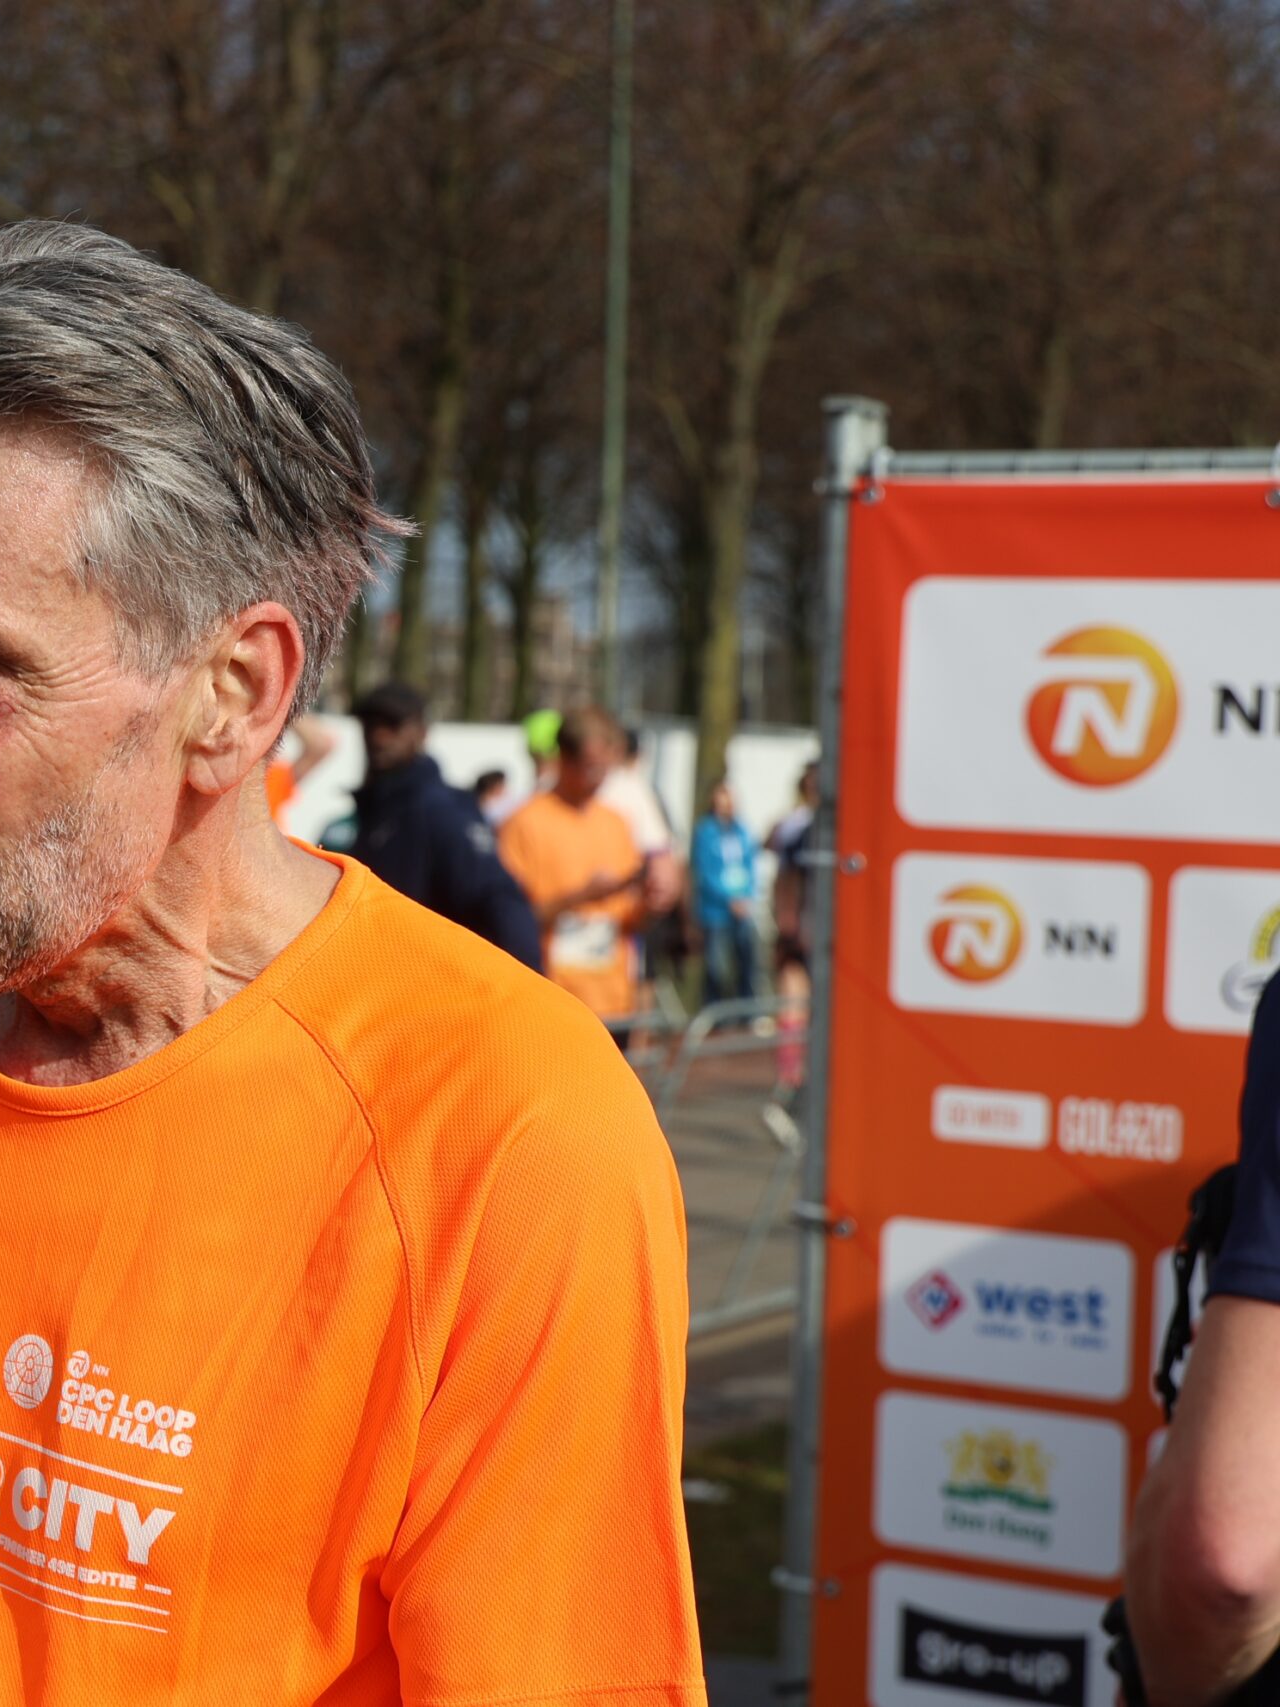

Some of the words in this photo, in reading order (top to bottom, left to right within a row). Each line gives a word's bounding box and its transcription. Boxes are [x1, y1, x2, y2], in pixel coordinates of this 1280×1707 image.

[1216, 686, 1280, 736] N
[1045, 921, 1117, 957] NN
[1058, 1096, 1183, 1163] GOLAZO
[92, 1364, 110, 1377] NN
[56, 1400, 108, 1435] DEN
[108, 1416, 193, 1457] HAAG
[61, 1379, 116, 1412] CPC
[118, 1394, 196, 1432] LOOP
[12, 1467, 177, 1565] CITY
[77, 1566, 137, 1590] EDITIE
[916, 1630, 1070, 1695] gro-up
